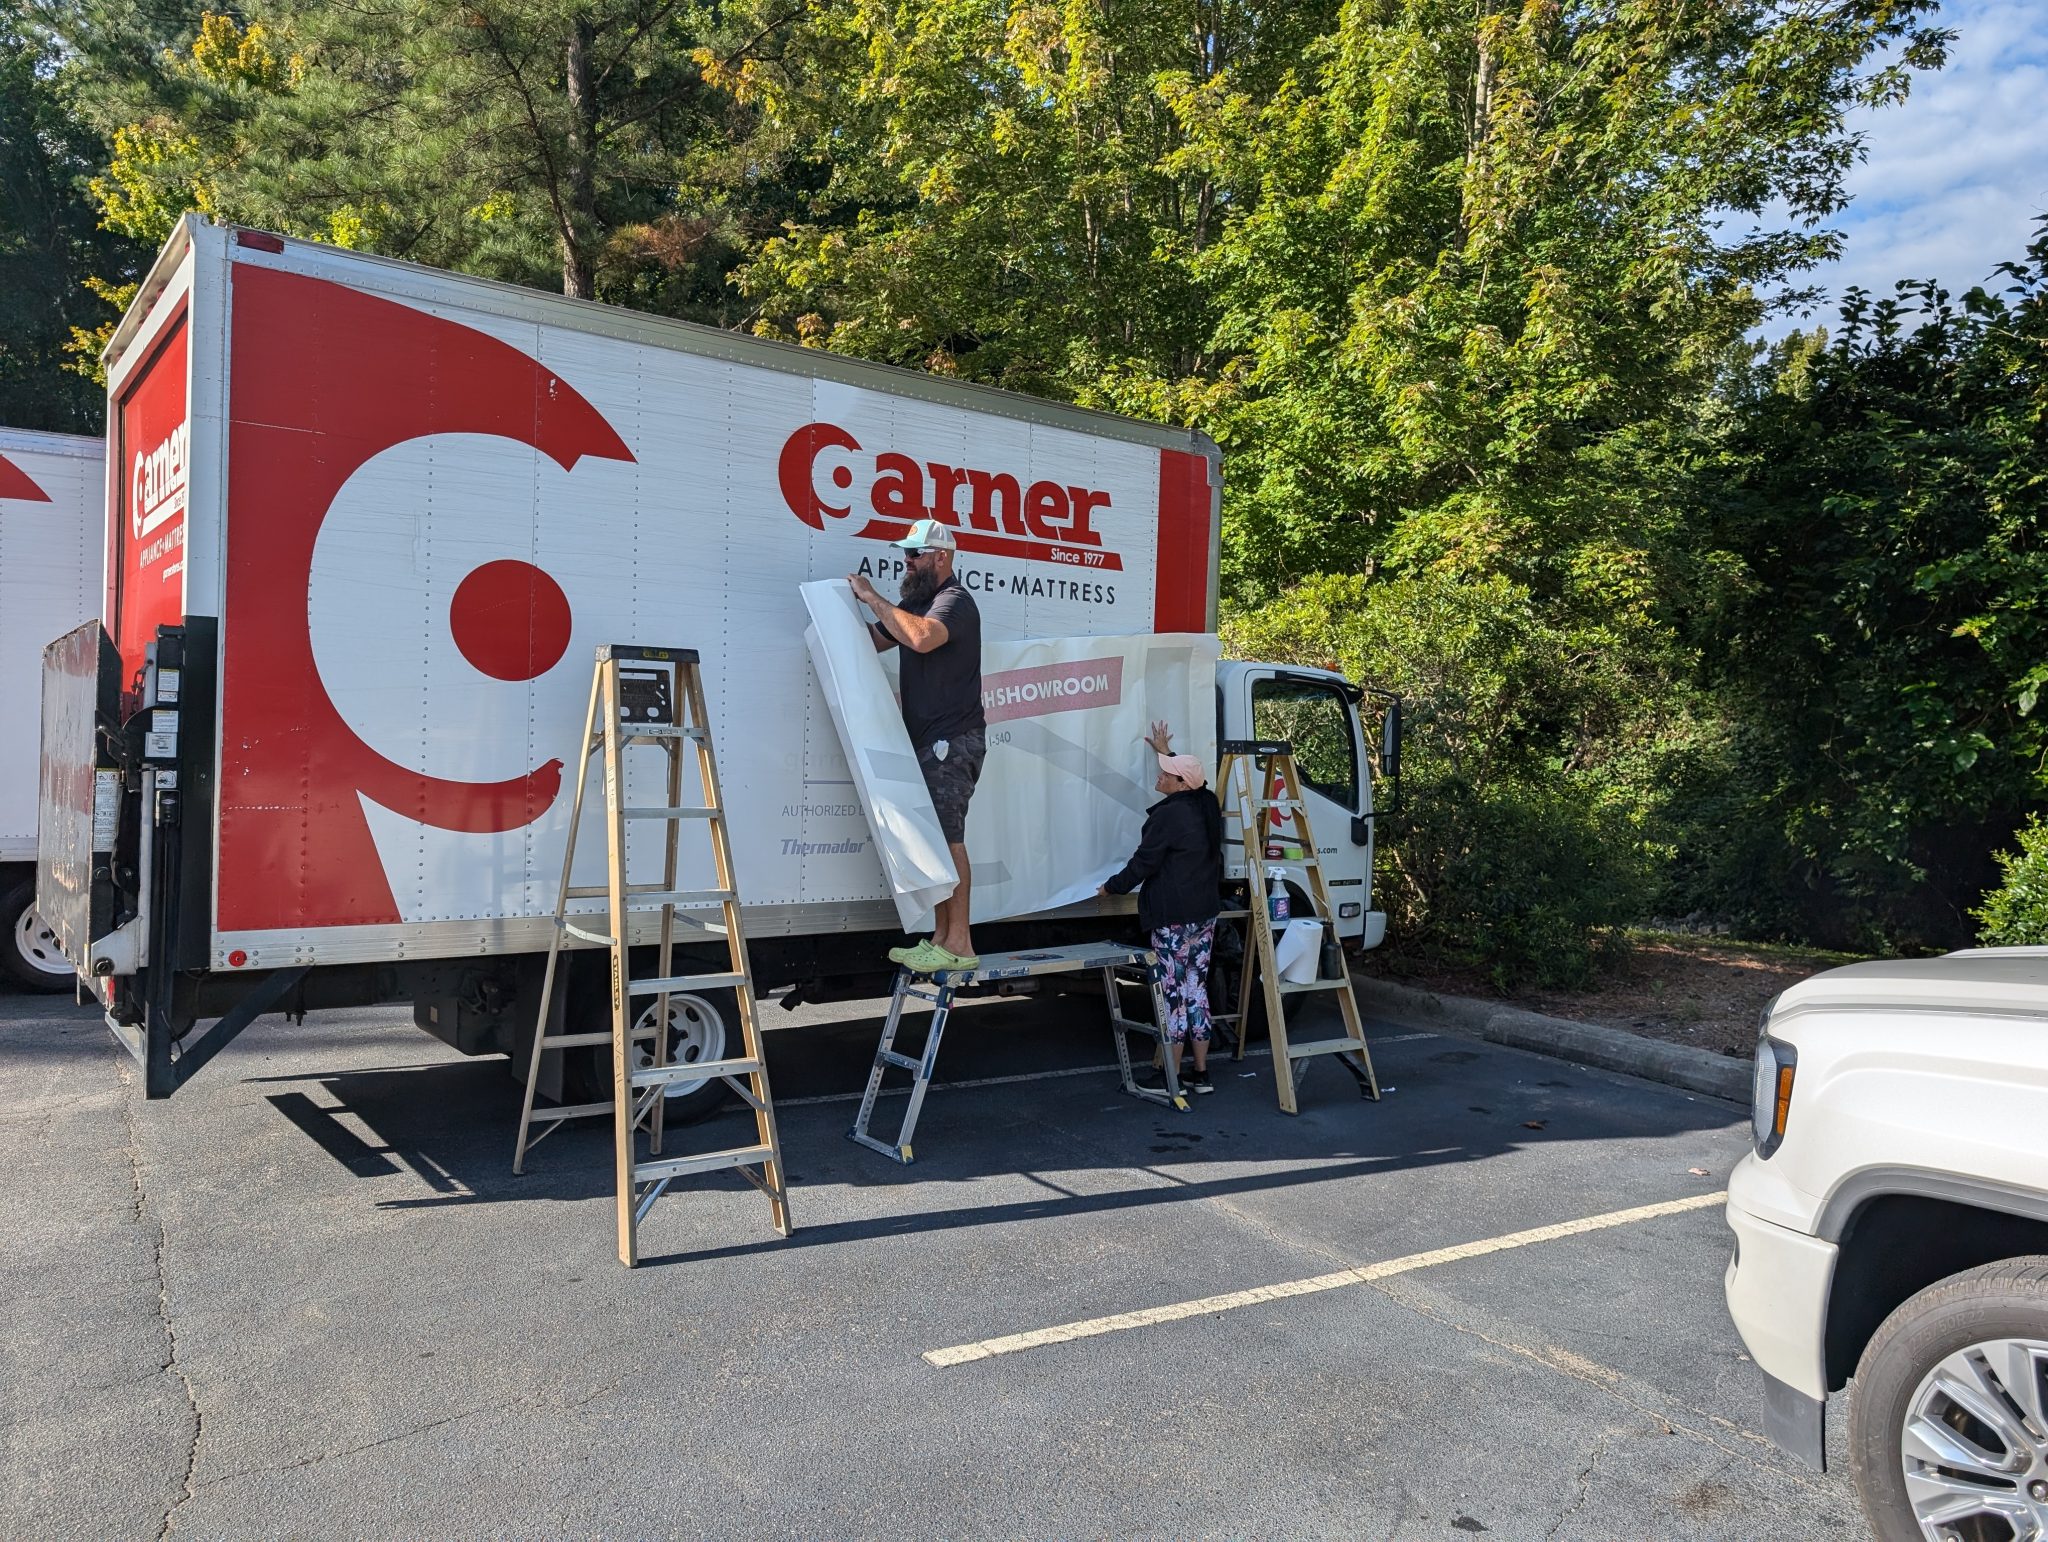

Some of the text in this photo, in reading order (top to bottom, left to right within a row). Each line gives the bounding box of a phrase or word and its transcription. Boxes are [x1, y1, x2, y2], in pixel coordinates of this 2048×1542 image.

[164, 523, 185, 555] MATTRE
[1051, 547, 1105, 567] Since 1977
[857, 556, 1116, 605] APPCE MATTRESS
[989, 731, 1011, 747] I-540
[782, 805, 855, 817] AUTHORIZED
[780, 838, 866, 856] Thermador
